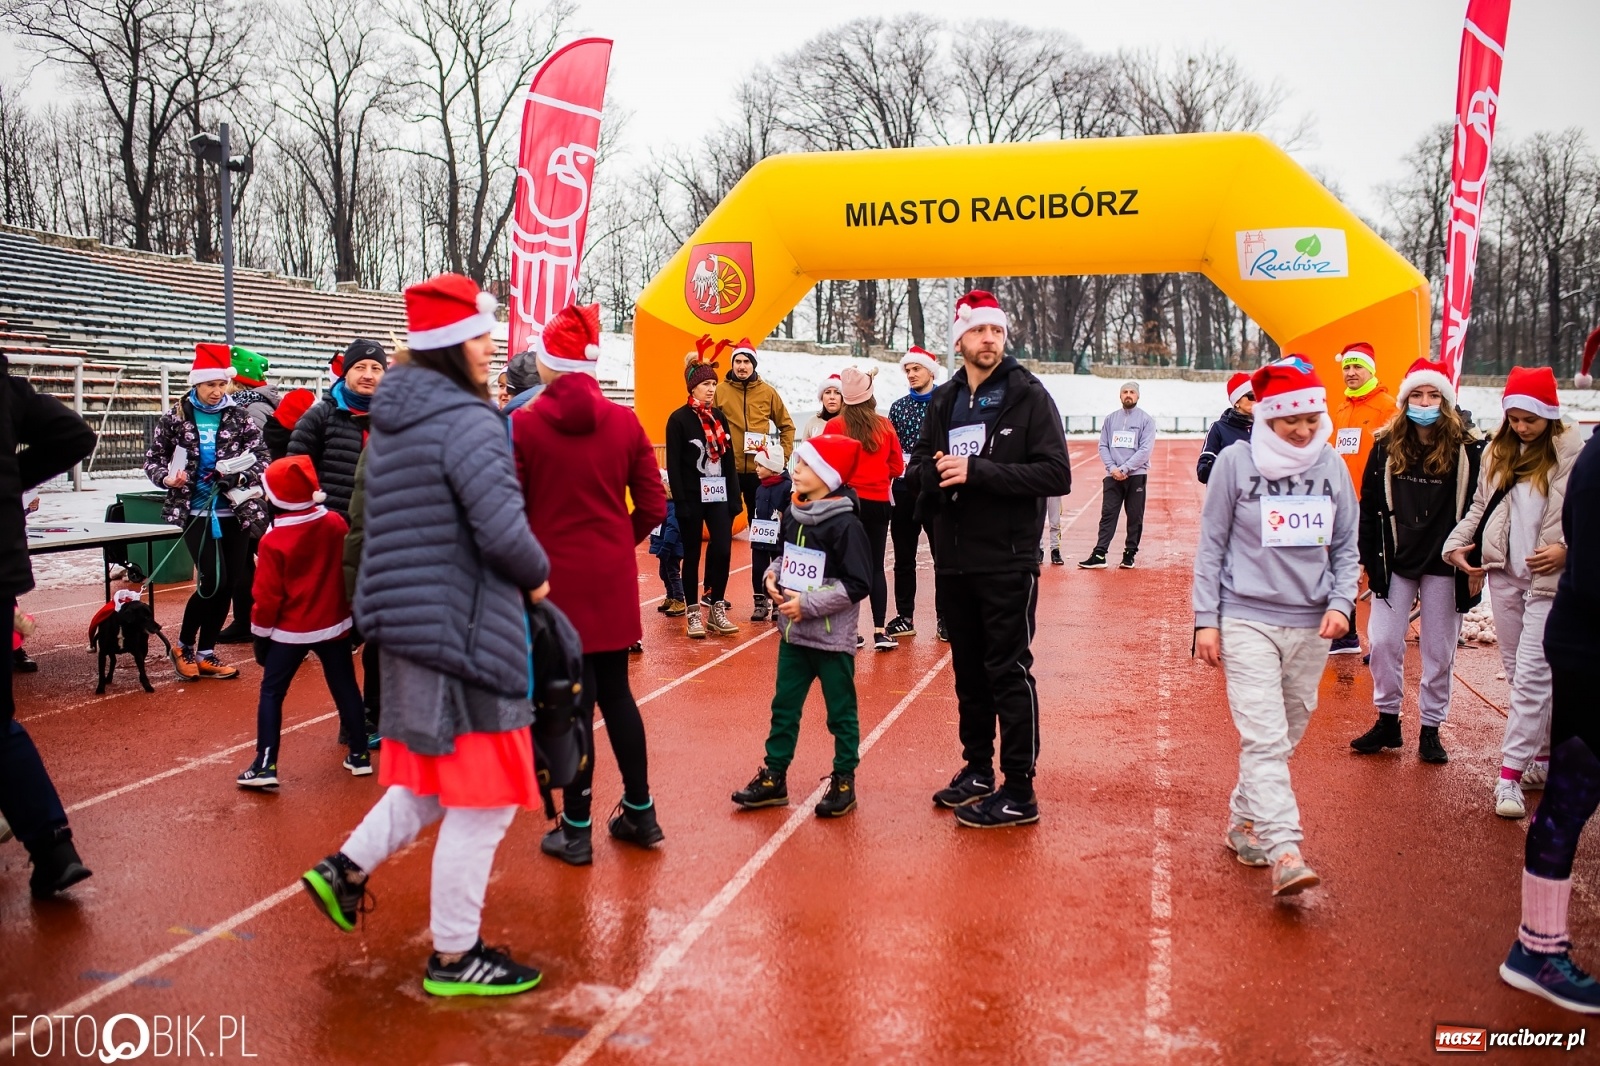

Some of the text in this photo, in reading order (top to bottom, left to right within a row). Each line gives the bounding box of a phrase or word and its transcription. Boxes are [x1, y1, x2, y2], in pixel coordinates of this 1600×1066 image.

[845, 186, 1139, 227] MIASTO RACIBÓRZ
[1249, 249, 1340, 279] Racibórz
[951, 440, 980, 457] 039
[1341, 437, 1358, 447] 052
[710, 486, 725, 495] 048
[1288, 512, 1325, 530] 014
[758, 527, 775, 537] 056
[789, 560, 818, 579] 038
